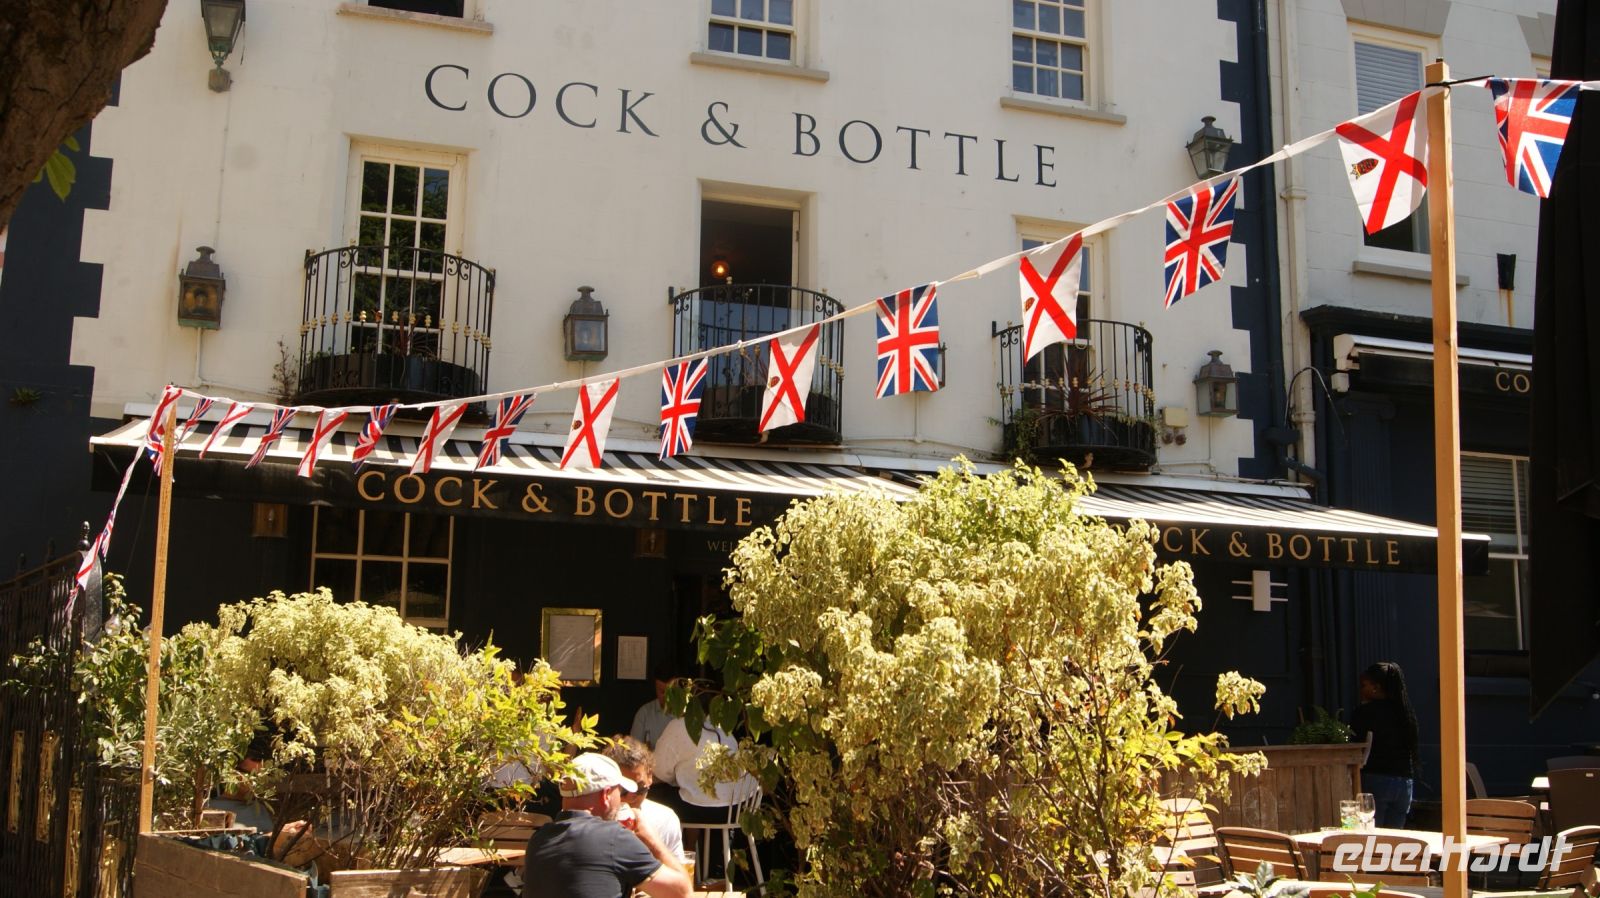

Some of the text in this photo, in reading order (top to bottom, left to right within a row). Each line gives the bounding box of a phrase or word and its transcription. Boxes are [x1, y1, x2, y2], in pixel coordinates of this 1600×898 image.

[425, 64, 1056, 188] COCK & BOTTLE
[357, 470, 752, 526] COCK & BOTTLE
[1108, 523, 1400, 565] CK & BOTTLE
